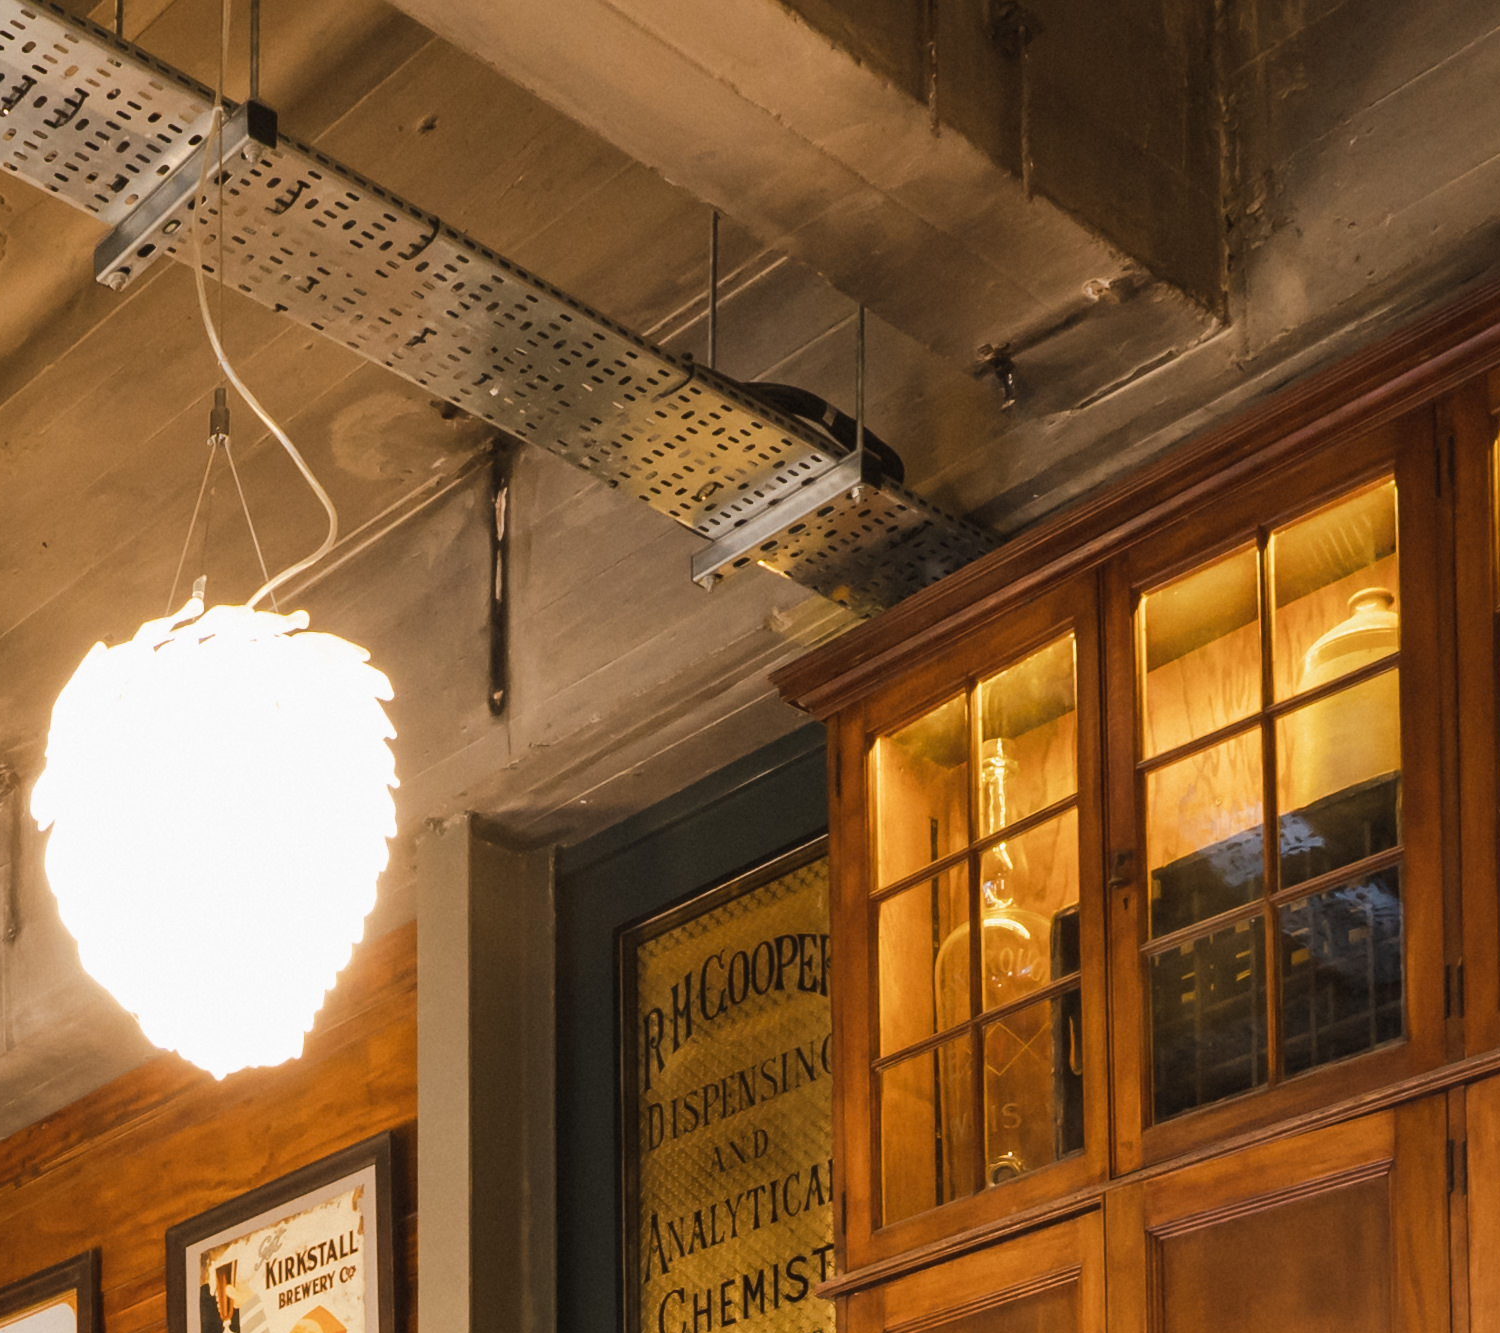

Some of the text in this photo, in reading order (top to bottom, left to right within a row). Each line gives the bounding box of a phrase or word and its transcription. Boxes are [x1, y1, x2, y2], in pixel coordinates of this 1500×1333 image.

[710, 1127, 769, 1175] AND
[264, 1229, 360, 1290] KIRKSTALL
[278, 1270, 336, 1310] BREWERY
